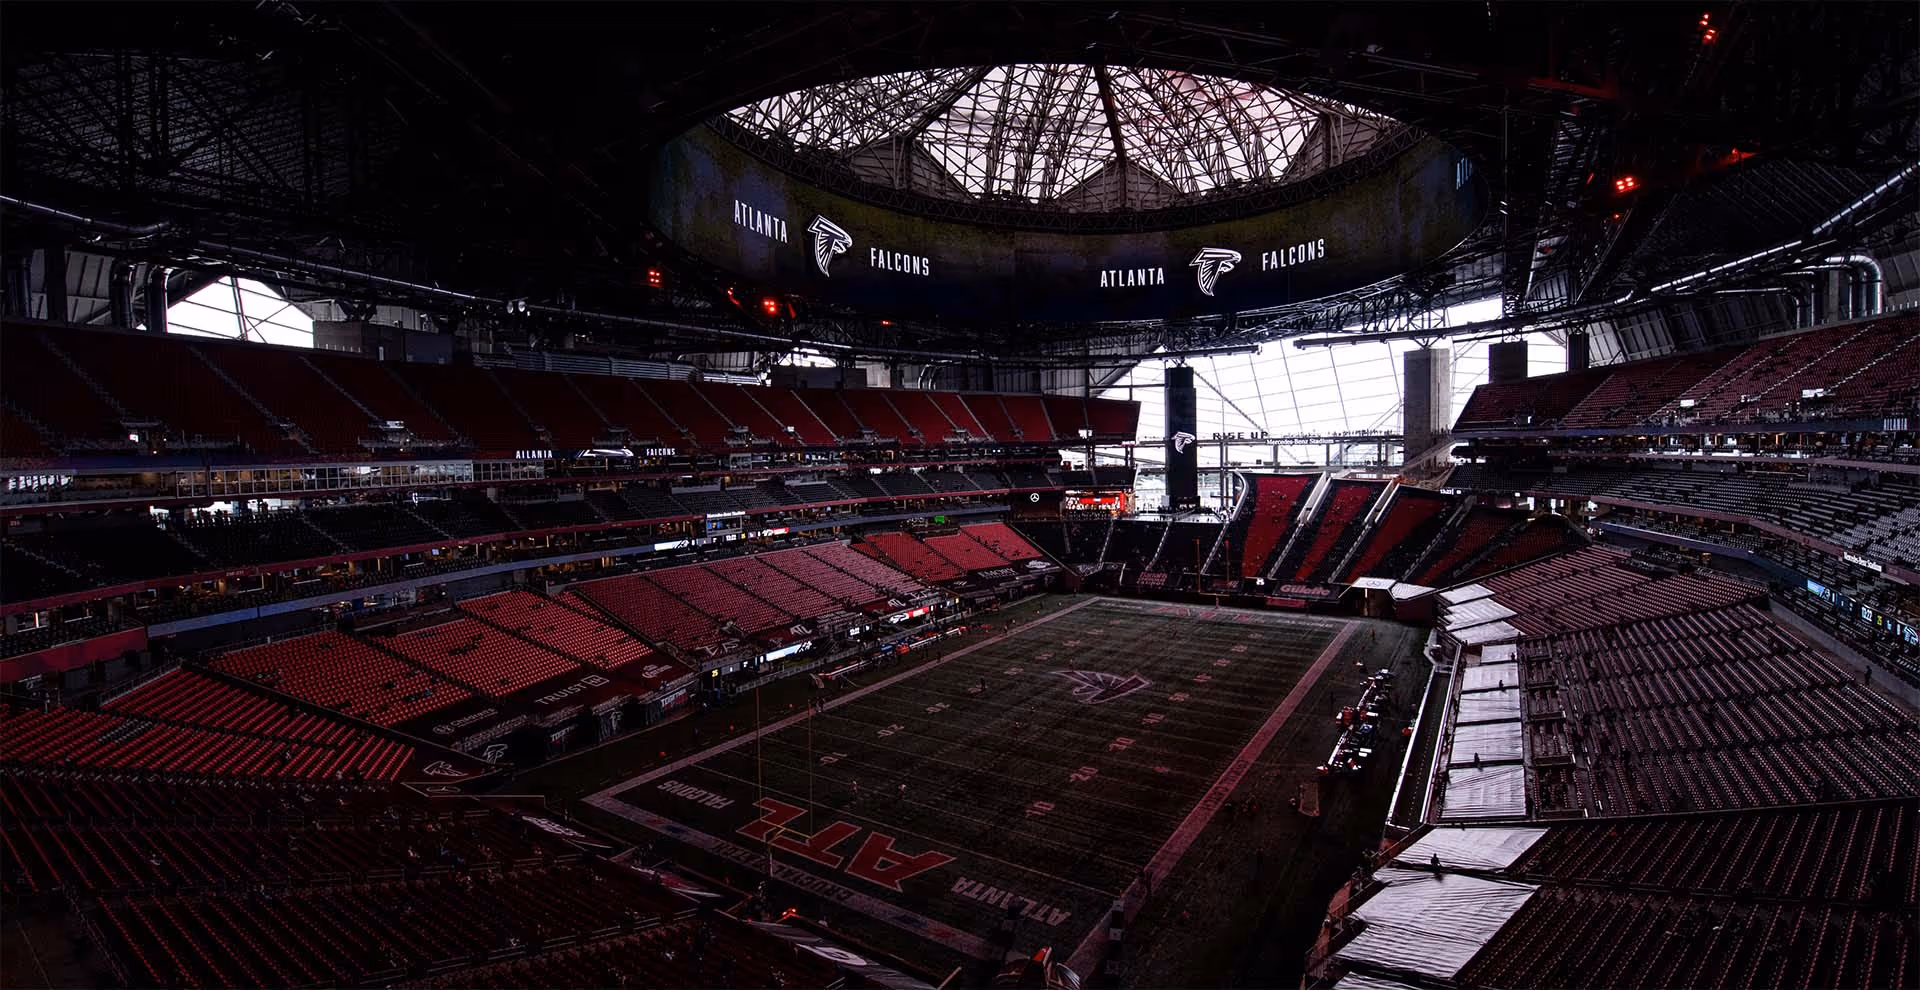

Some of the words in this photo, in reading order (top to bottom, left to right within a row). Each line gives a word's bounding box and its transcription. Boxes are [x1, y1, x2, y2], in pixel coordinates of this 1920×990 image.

[733, 199, 789, 244] ATLANTA
[870, 247, 930, 277] FALCONS
[1100, 267, 1165, 288] ATLANTA
[1261, 238, 1325, 272] FALCONS
[1212, 431, 1245, 440] RISE
[1250, 431, 1268, 440] UP
[515, 449, 553, 460] ATLANTA
[646, 447, 675, 457] FALCONS
[1280, 583, 1330, 597] Gillette
[534, 682, 588, 705] TRUIST
[656, 779, 736, 810] FALCONS
[736, 796, 958, 893] ATL
